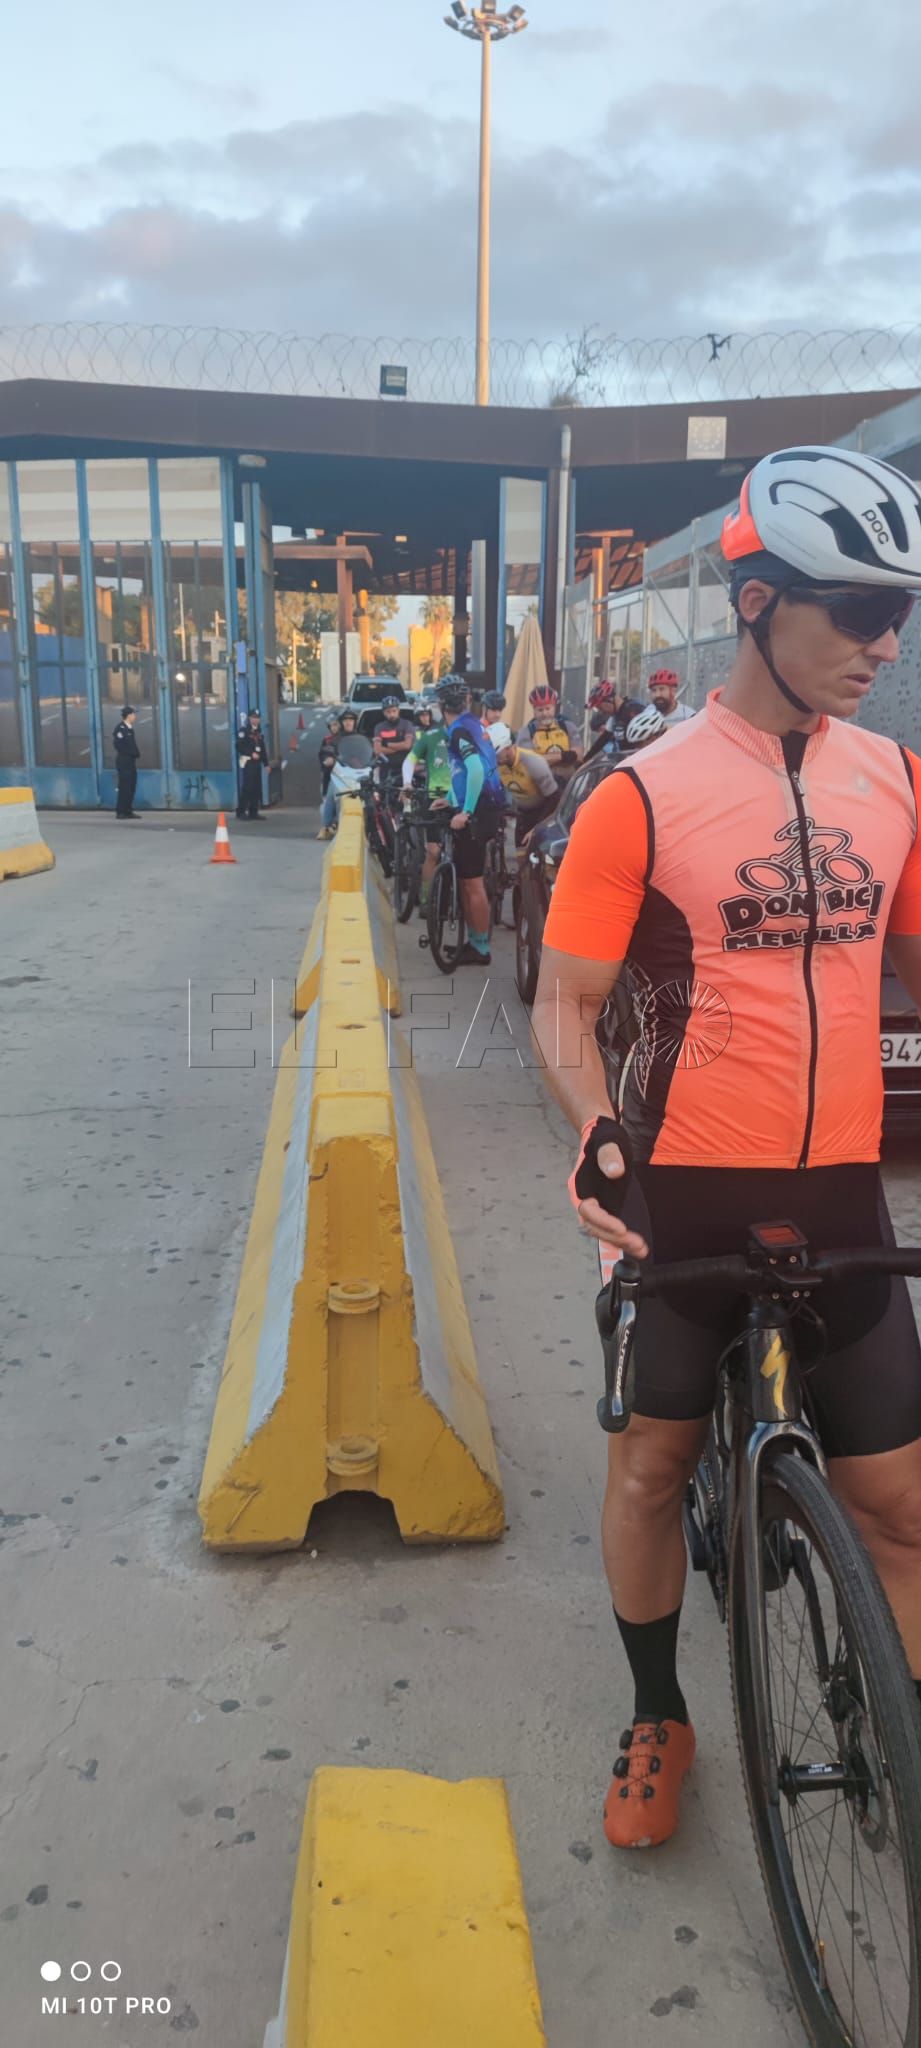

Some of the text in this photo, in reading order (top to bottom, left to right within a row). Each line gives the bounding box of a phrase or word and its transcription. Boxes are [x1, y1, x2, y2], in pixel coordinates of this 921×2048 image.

[718, 881, 885, 934] DON BICI
[722, 921, 877, 952] MELILLA
